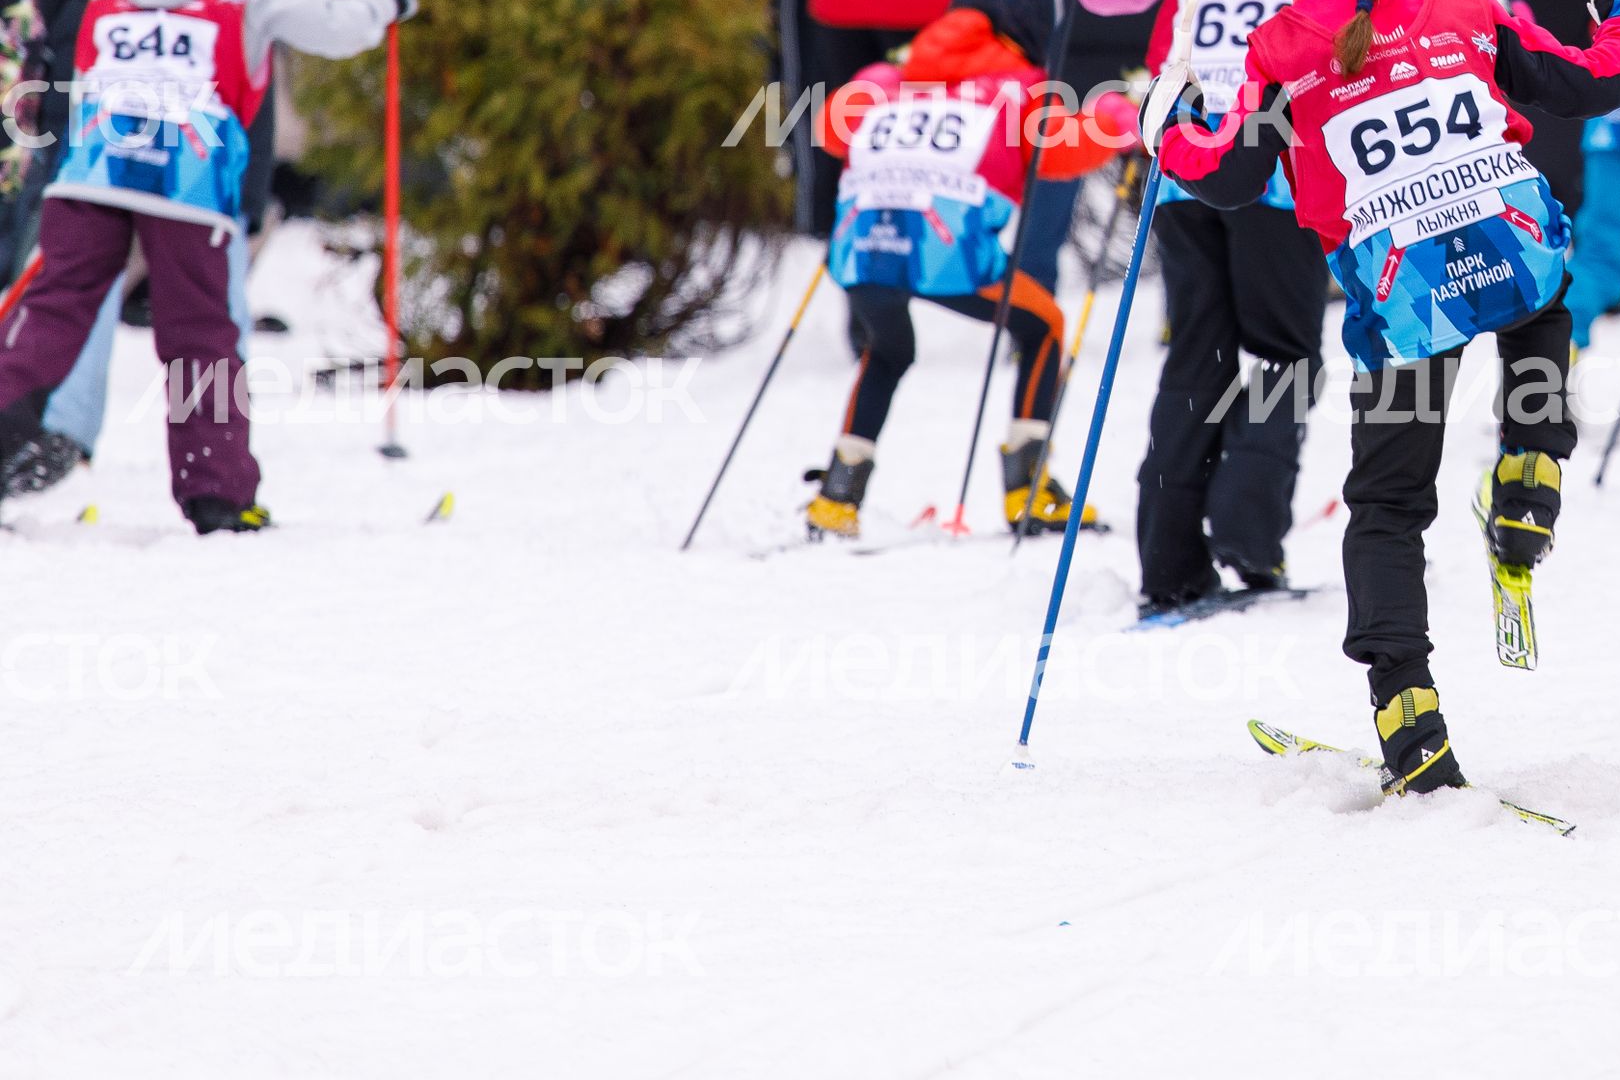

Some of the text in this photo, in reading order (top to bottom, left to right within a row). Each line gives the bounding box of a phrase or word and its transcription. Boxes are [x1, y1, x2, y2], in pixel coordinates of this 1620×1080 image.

[1350, 90, 1484, 176] 654
[1353, 150, 1536, 232] МАНЖОСОВСКАЯ
[1416, 200, 1482, 236] ЛЫЖНЯ
[1430, 258, 1514, 303] ЛАЗУТИНОЙ
[1446, 252, 1486, 279] ПАРК
